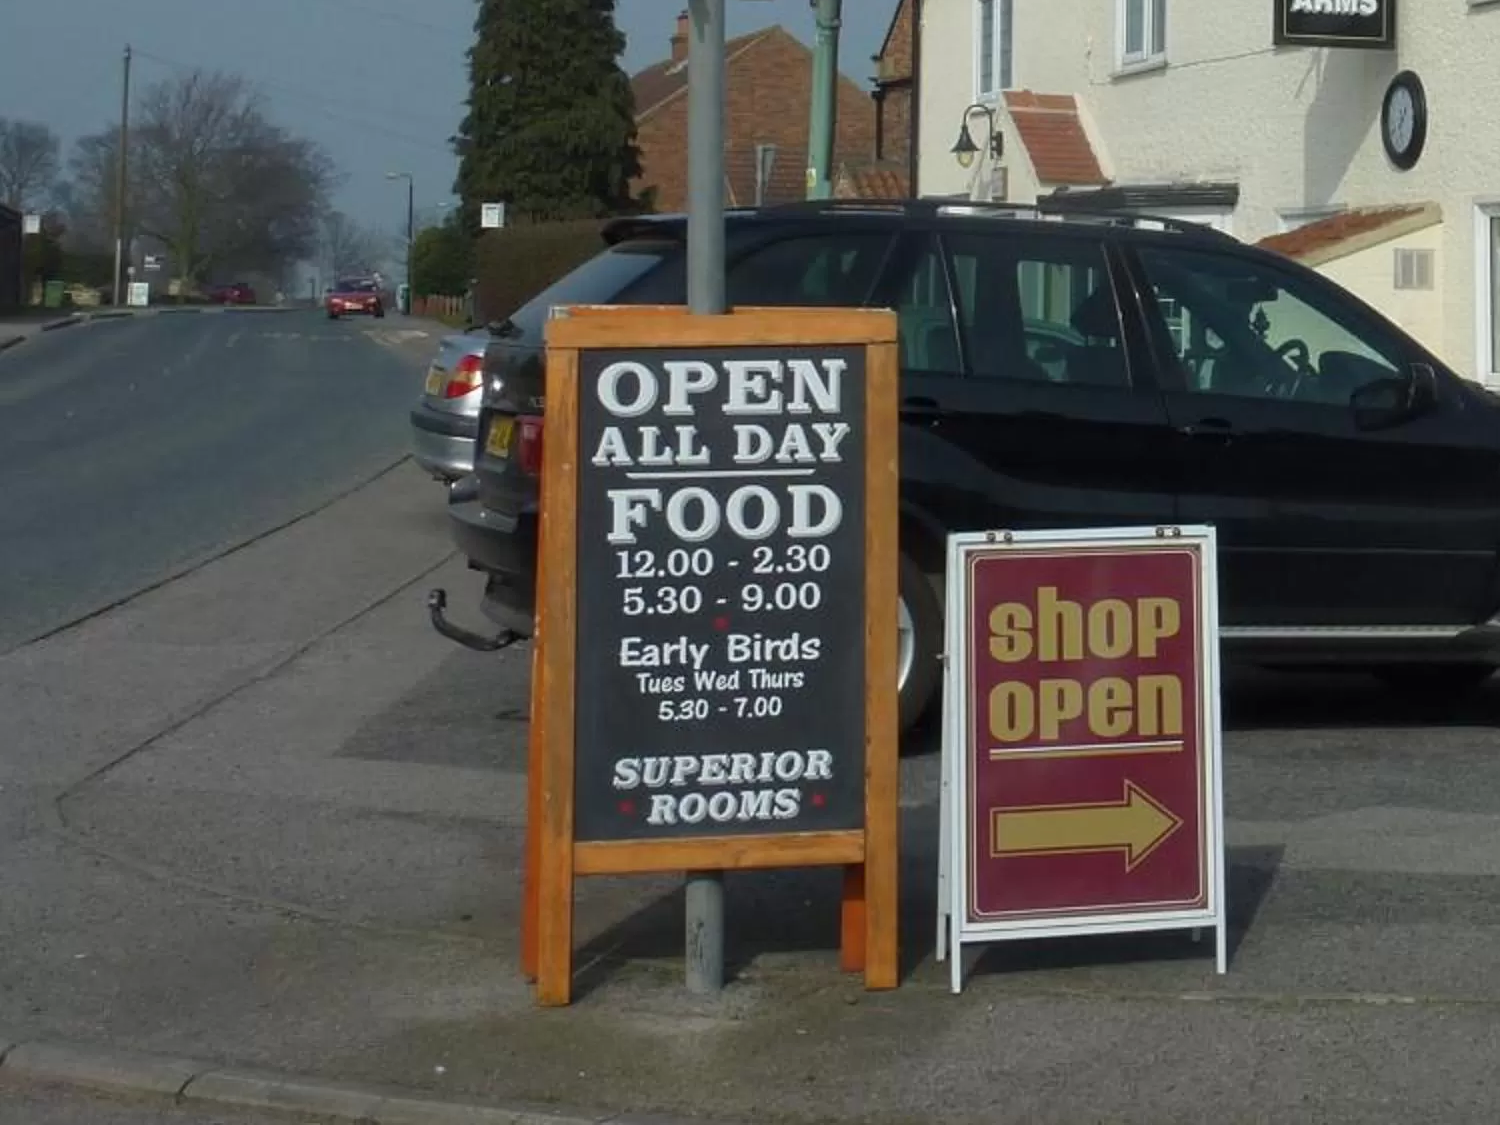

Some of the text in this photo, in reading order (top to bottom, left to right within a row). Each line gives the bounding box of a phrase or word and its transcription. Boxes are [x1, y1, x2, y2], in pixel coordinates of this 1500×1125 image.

[598, 359, 847, 417] OPEN
[592, 423, 851, 466] ALL DAY
[607, 484, 842, 544] FOOD
[616, 549, 714, 578] 12.00
[752, 544, 831, 574] 2.30
[622, 586, 702, 616] 5.30
[741, 581, 821, 612] 9.00
[989, 586, 1181, 662] shop
[619, 633, 821, 669] Early Birds
[636, 668, 805, 694] Tues Wed Thurs
[658, 700, 709, 720] 5.30
[734, 696, 783, 718] 7.00
[989, 674, 1183, 742] open
[613, 749, 833, 789] SUPERIOR
[646, 788, 801, 824] ROOMS
